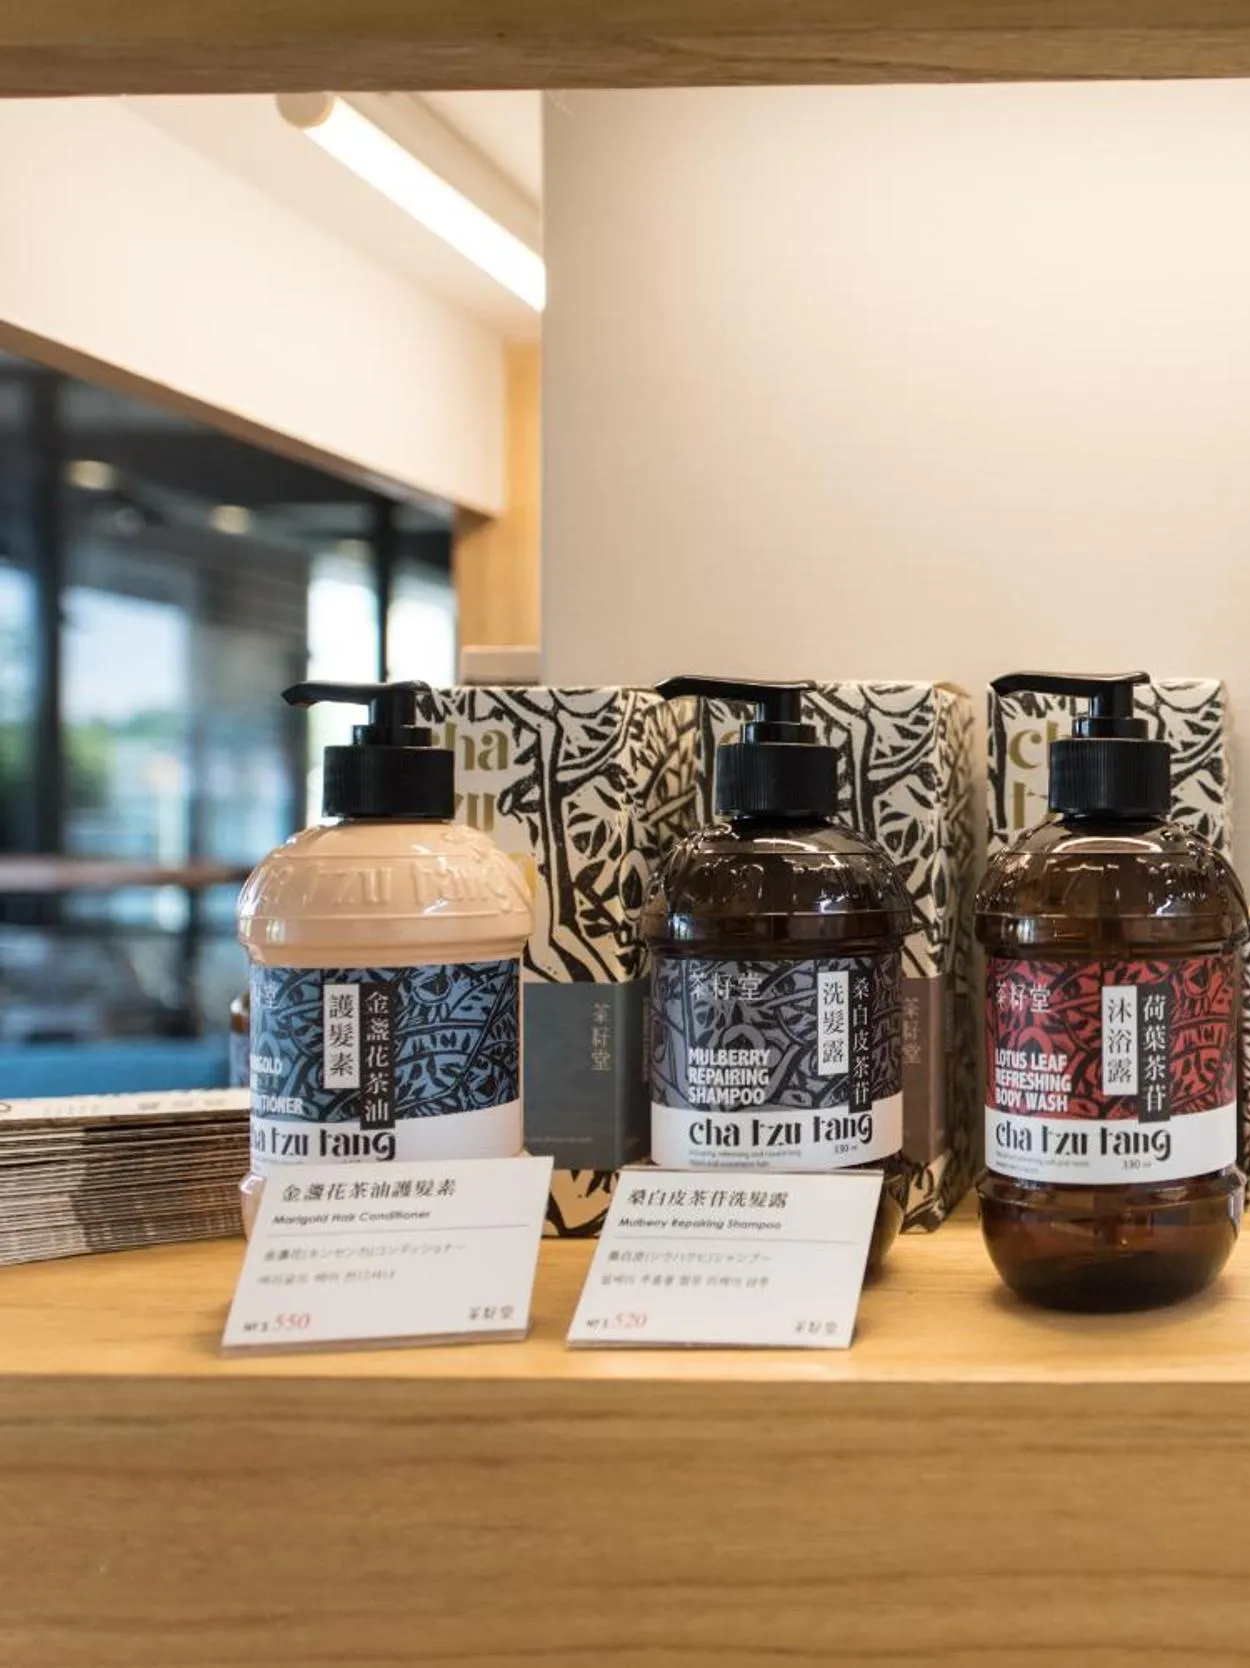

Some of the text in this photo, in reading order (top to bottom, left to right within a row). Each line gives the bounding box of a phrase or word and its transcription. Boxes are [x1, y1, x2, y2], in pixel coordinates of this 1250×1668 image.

[432, 721, 509, 771] ha
[690, 972, 762, 1000] 茶籽堂
[329, 994, 354, 1077] 護髮素
[822, 982, 845, 1064] 洗髮露
[1107, 996, 1132, 1083] 沐浴露
[366, 991, 390, 1123] 金盞花茶油
[688, 1048, 771, 1066] MULBERRY
[995, 1048, 1067, 1073] LOTUS LEAF
[688, 1068, 769, 1086] REPAIRING
[995, 1068, 1072, 1092] REFRESHING
[688, 1087, 765, 1104] SHAMPOO
[995, 1086, 1068, 1112] BODY WASH
[689, 1113, 873, 1147] cha tzu tang
[996, 1121, 1032, 1151] cha
[1042, 1125, 1088, 1156] tzu
[1100, 1127, 1171, 1161] tang
[271, 1127, 308, 1156] tzu
[320, 1129, 396, 1161] tang
[273, 1210, 430, 1226] Marigold Hair Conditioner
[618, 1218, 782, 1231] Mulberry Repairing Shampoo
[273, 1313, 311, 1331] 550
[613, 1312, 648, 1328] 520
